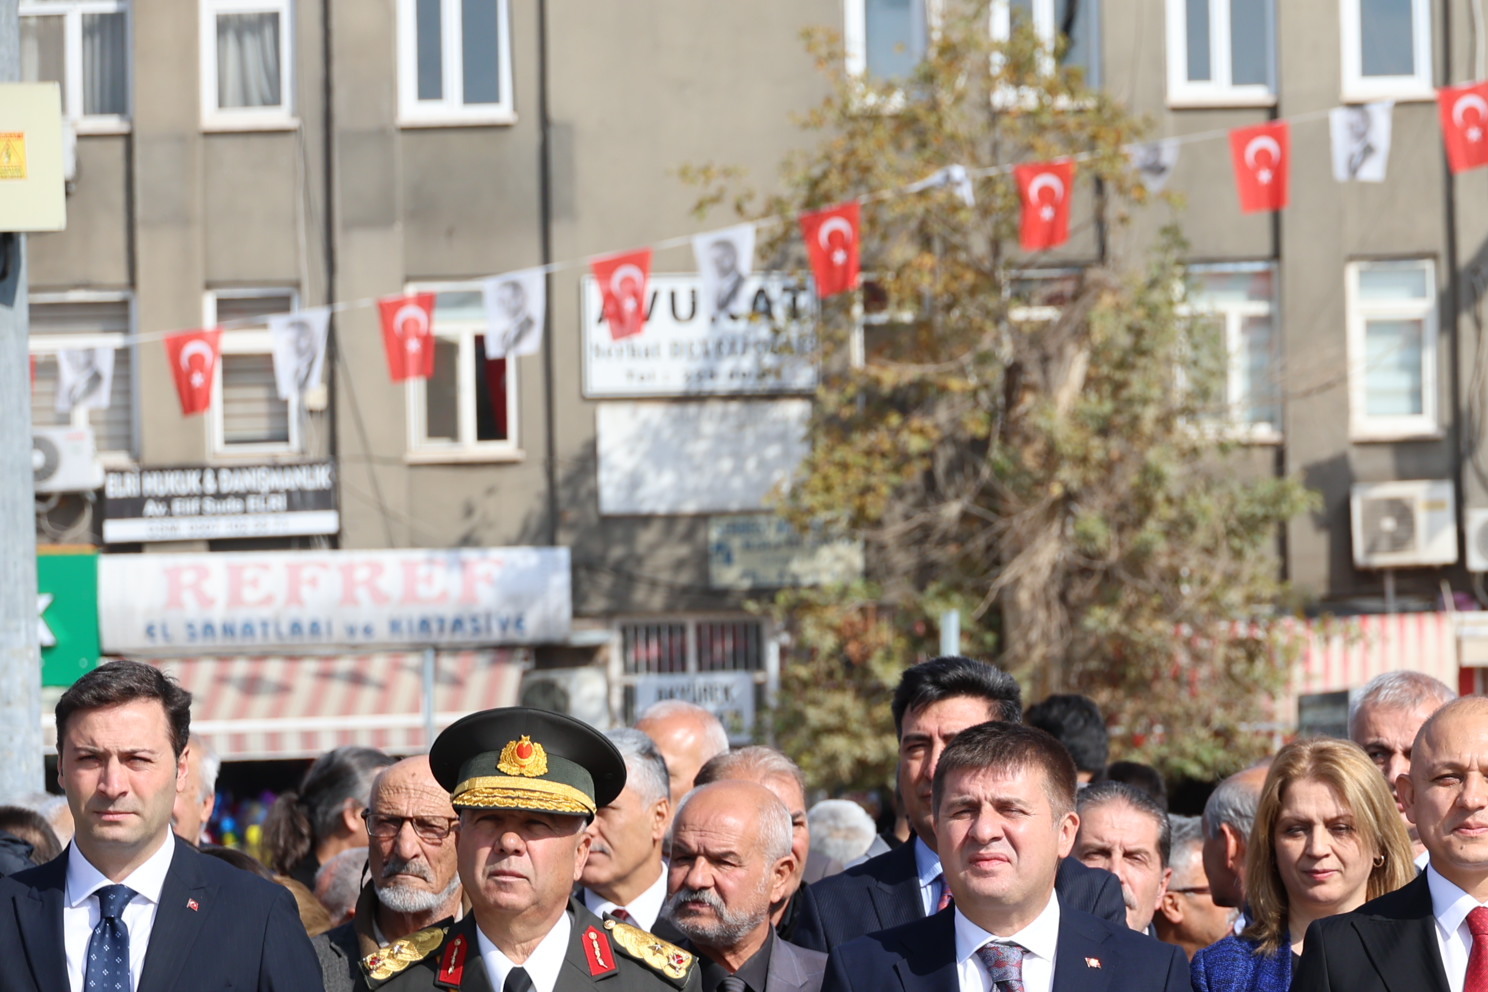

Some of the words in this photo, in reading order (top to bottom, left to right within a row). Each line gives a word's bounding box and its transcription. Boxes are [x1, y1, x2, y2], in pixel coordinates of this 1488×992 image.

[597, 287, 807, 323] VUAT
[142, 468, 201, 496] HUKUK
[203, 468, 217, 494] &
[163, 557, 505, 610] REFREF
[186, 615, 332, 643] SANATLARI
